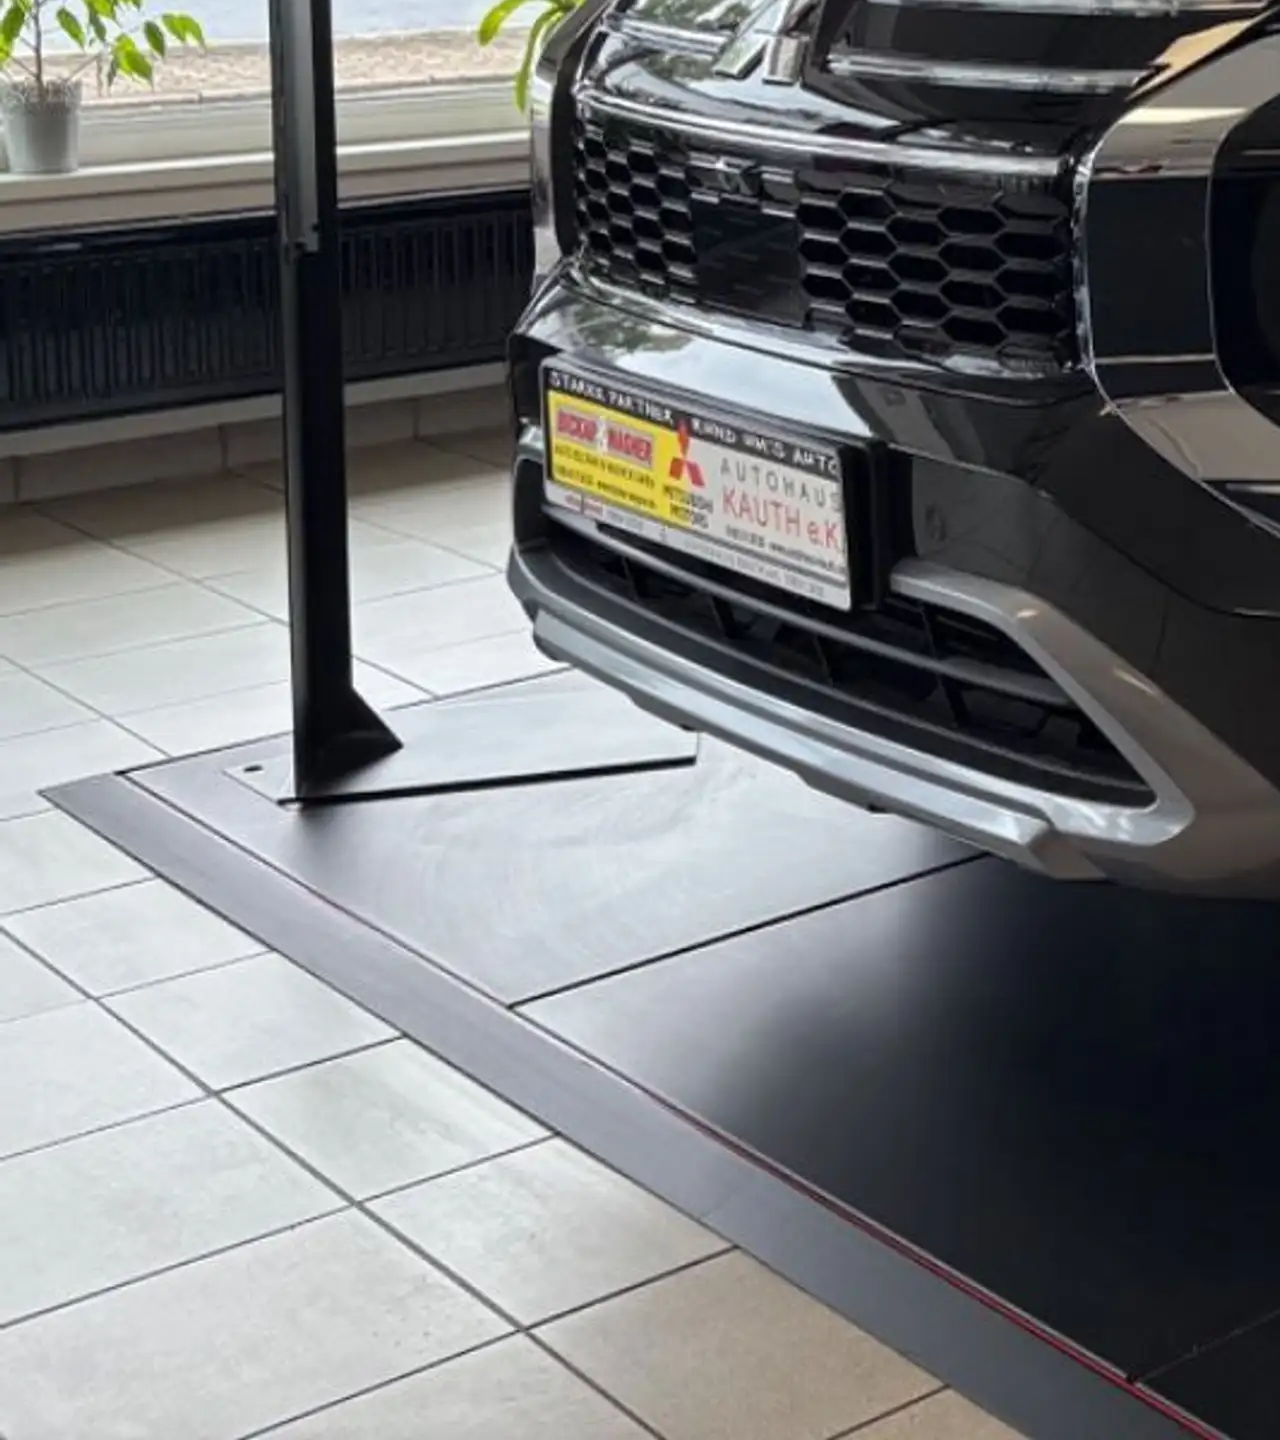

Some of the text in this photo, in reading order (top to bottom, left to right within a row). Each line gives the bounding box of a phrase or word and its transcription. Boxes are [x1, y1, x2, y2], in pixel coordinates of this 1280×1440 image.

[720, 457, 841, 509] AUTOHAUS
[793, 449, 839, 473] AUTO
[722, 485, 801, 537] KAUTH
